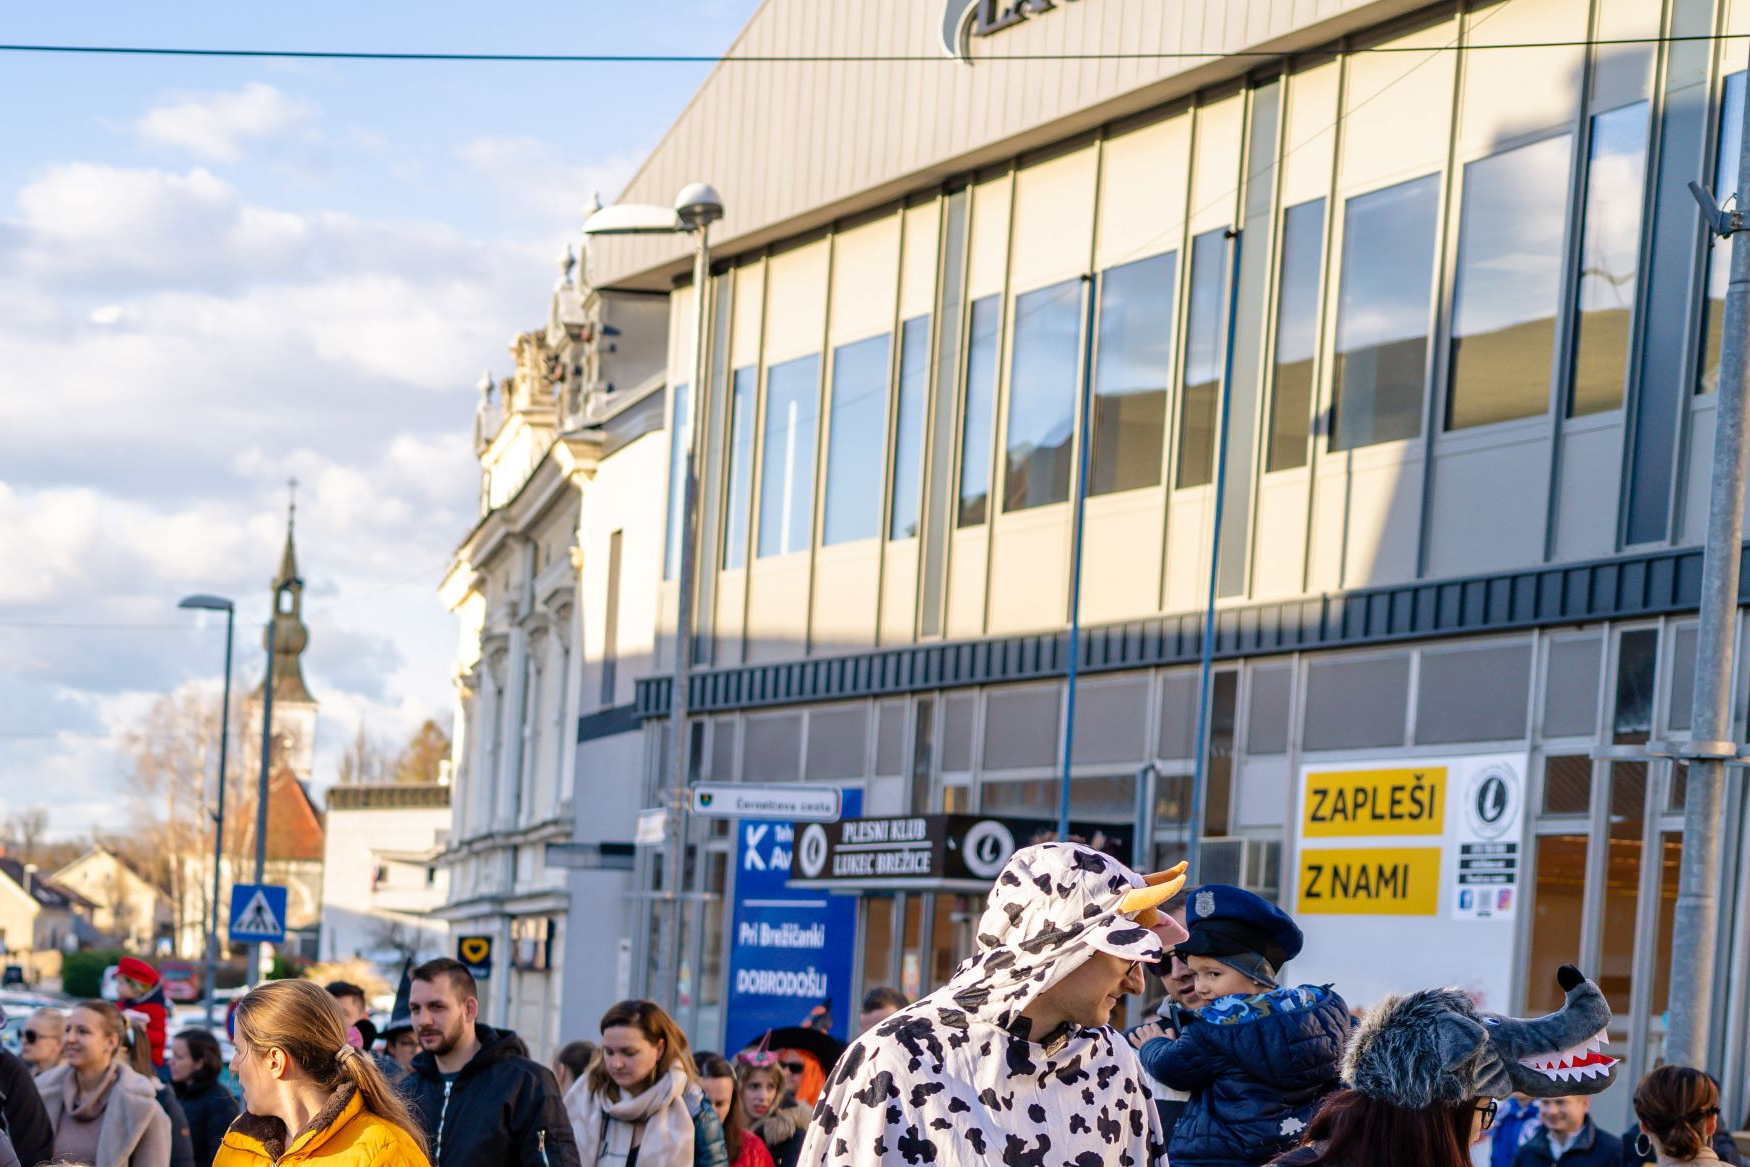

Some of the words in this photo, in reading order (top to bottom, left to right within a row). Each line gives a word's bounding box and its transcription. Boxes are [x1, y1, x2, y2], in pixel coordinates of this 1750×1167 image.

[1310, 773, 1436, 822] ZAPLEŠI
[842, 820, 889, 843] PLESNI
[890, 818, 926, 840] KLUB
[832, 853, 875, 876] LUKEC
[874, 849, 932, 875] BREŽICE
[1305, 864, 1324, 899] Z
[1330, 863, 1408, 899] NAMI
[739, 922, 758, 945] Pri
[736, 966, 828, 999] DOBRODOŠLI
